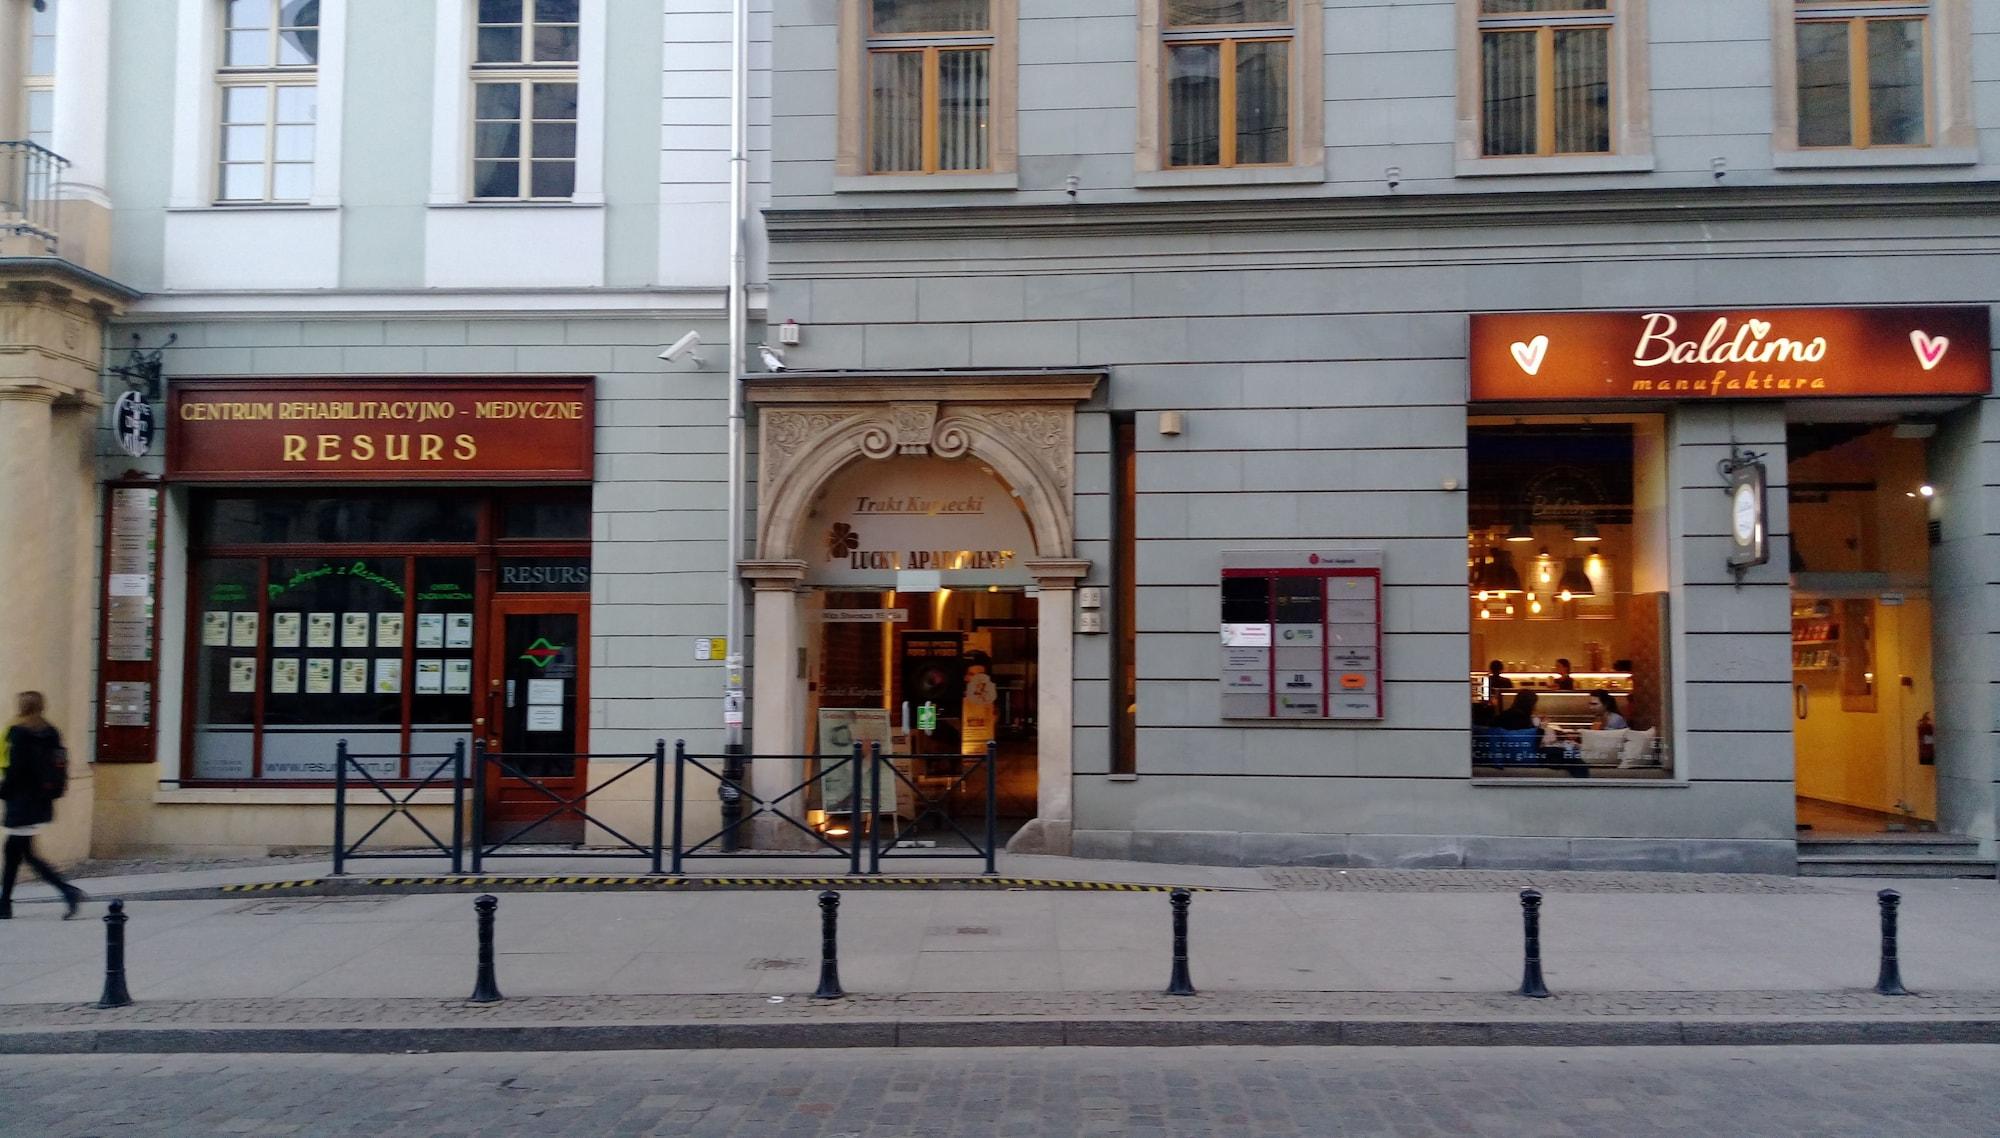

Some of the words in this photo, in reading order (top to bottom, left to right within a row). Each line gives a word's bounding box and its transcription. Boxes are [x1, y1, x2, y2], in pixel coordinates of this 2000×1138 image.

[1633, 313, 1827, 366] Baldimo
[1632, 370, 1826, 395] manufaktura
[180, 402, 273, 421] CENTRUM
[279, 401, 455, 423] REHABILITACYJNO
[475, 401, 584, 420] MEDYCZNE
[283, 434, 477, 462] RESURS
[503, 566, 588, 584] RESURS
[265, 762, 396, 774] www.resur.com.pl
